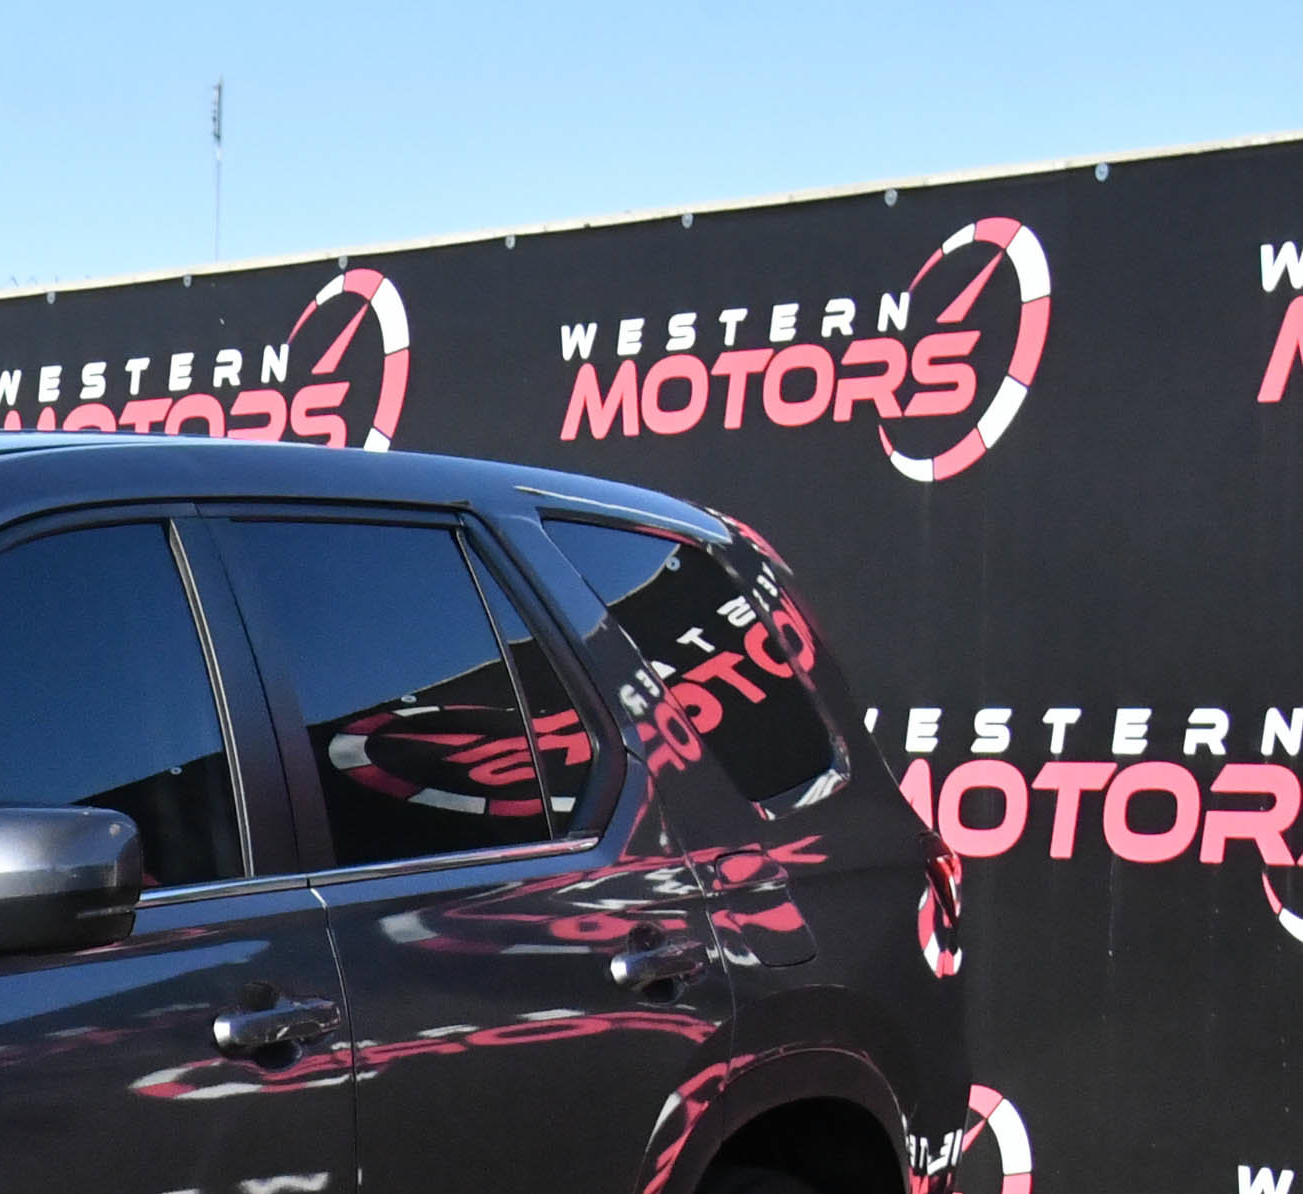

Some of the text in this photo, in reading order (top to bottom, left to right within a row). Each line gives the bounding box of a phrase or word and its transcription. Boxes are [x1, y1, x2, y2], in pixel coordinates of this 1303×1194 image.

[561, 292, 911, 361] WESTERN
[560, 330, 981, 441] MOTORS
[864, 707, 1303, 757] ESTERN
